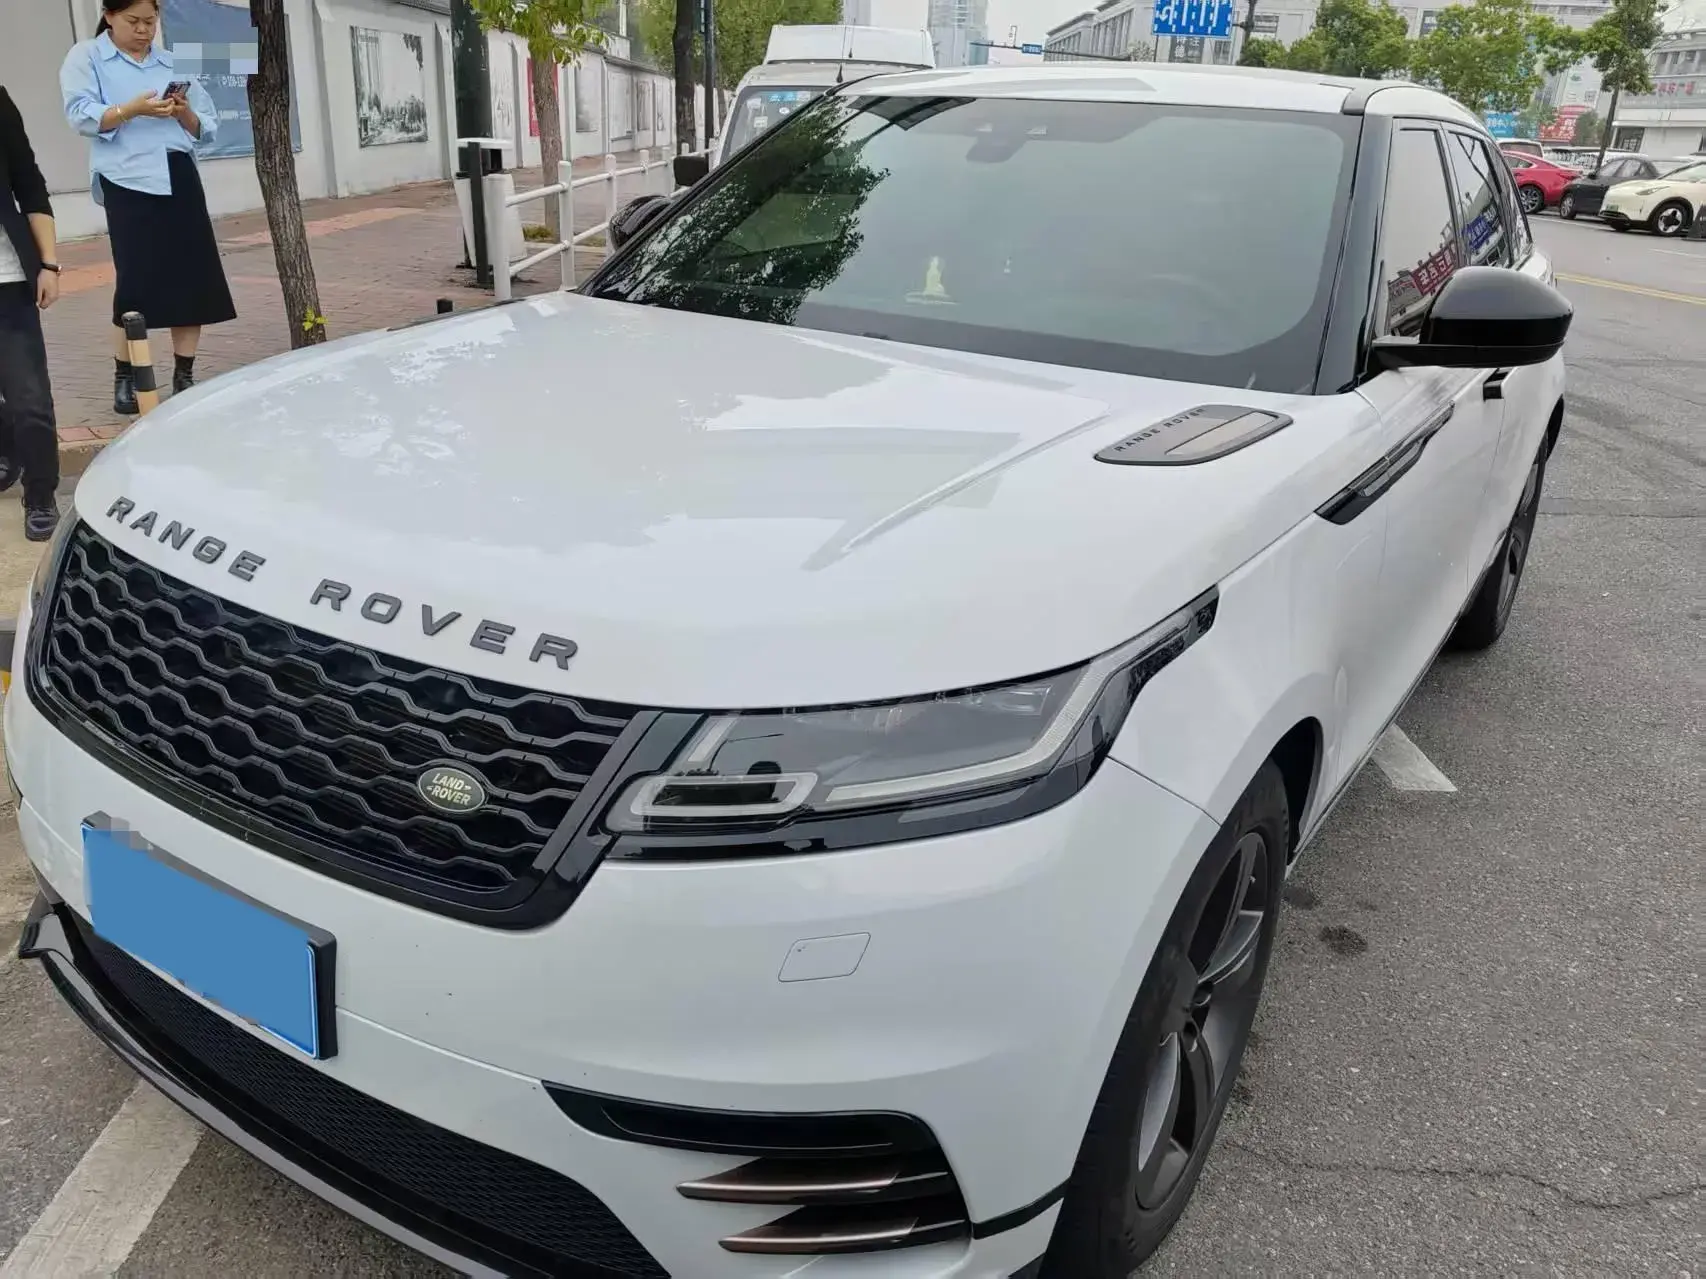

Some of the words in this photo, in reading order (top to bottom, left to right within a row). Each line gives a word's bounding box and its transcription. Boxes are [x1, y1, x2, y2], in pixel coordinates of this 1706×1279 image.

[1114, 428, 1160, 452] RANGE
[1163, 408, 1204, 427] ROVER
[105, 496, 266, 582] RANGE
[310, 578, 579, 671] ROVER
[432, 773, 464, 790] LAND
[432, 785, 471, 805] ROVER
